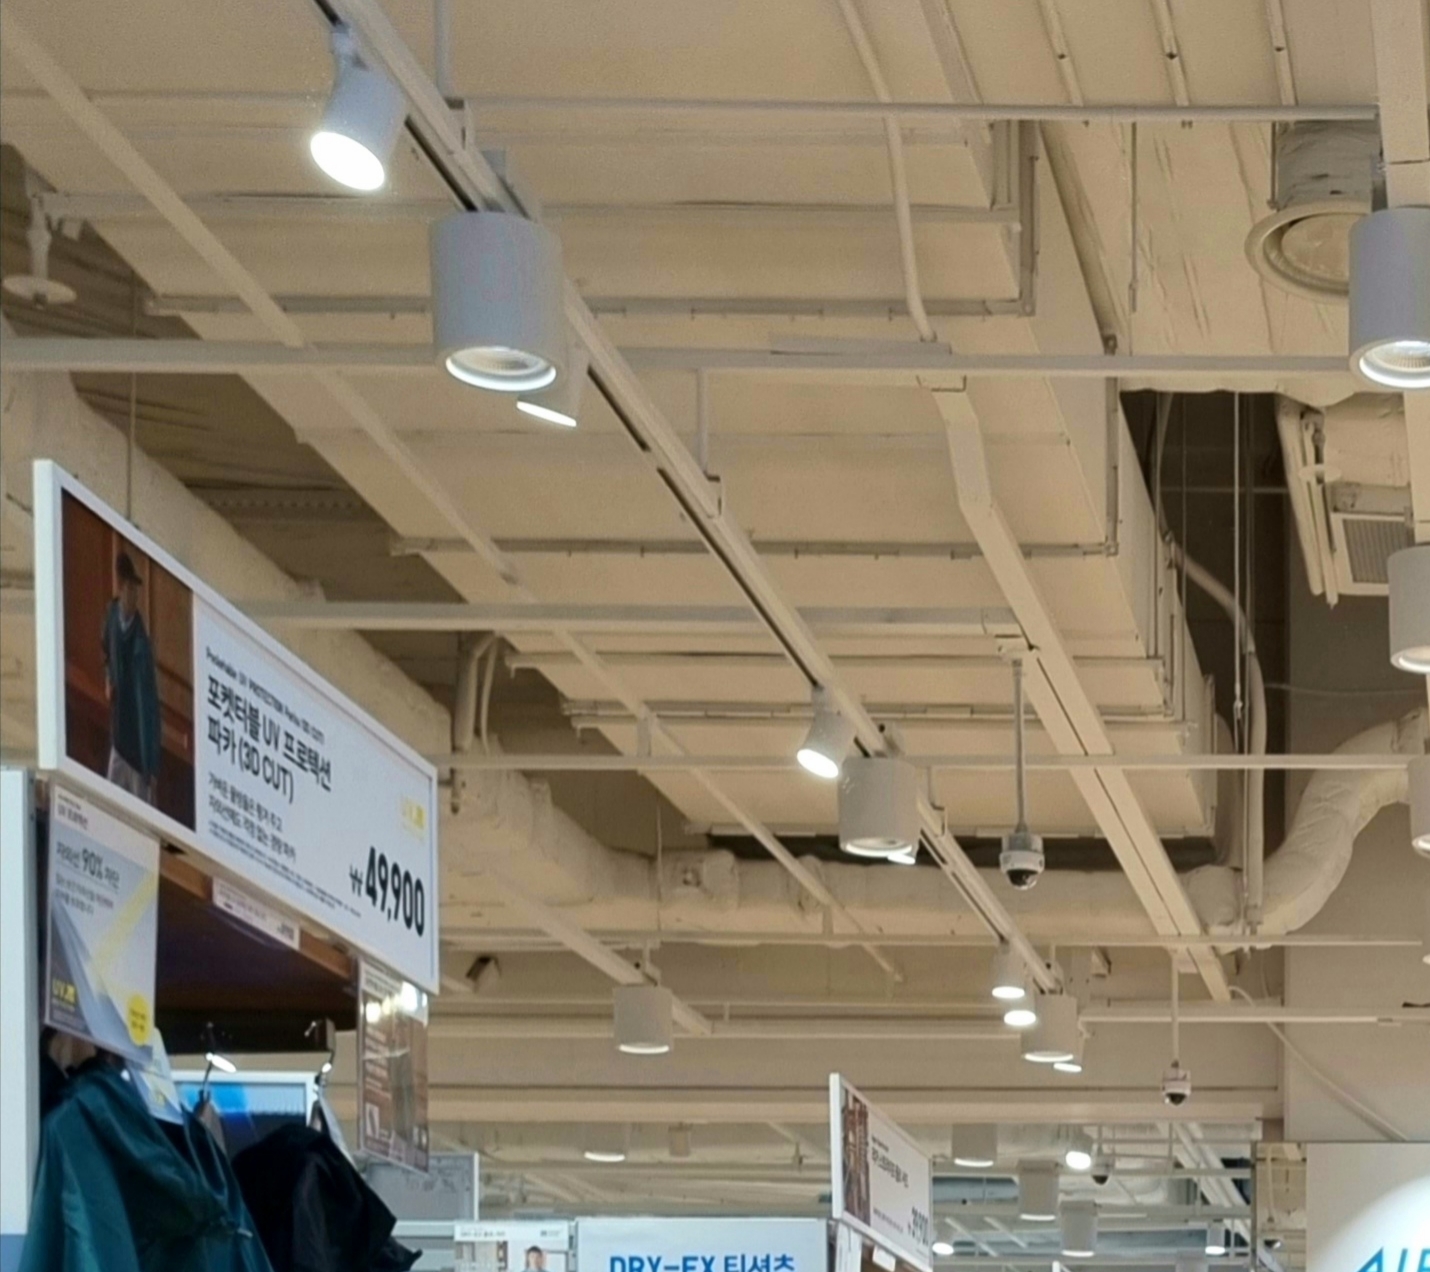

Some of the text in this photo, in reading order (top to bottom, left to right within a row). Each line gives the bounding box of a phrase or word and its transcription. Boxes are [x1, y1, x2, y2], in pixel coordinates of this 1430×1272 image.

[207, 674, 332, 793] 포켓터블 UV 프로텍션
[207, 715, 294, 804] 파카 (3D CUT)
[349, 846, 425, 938] ₩49,900
